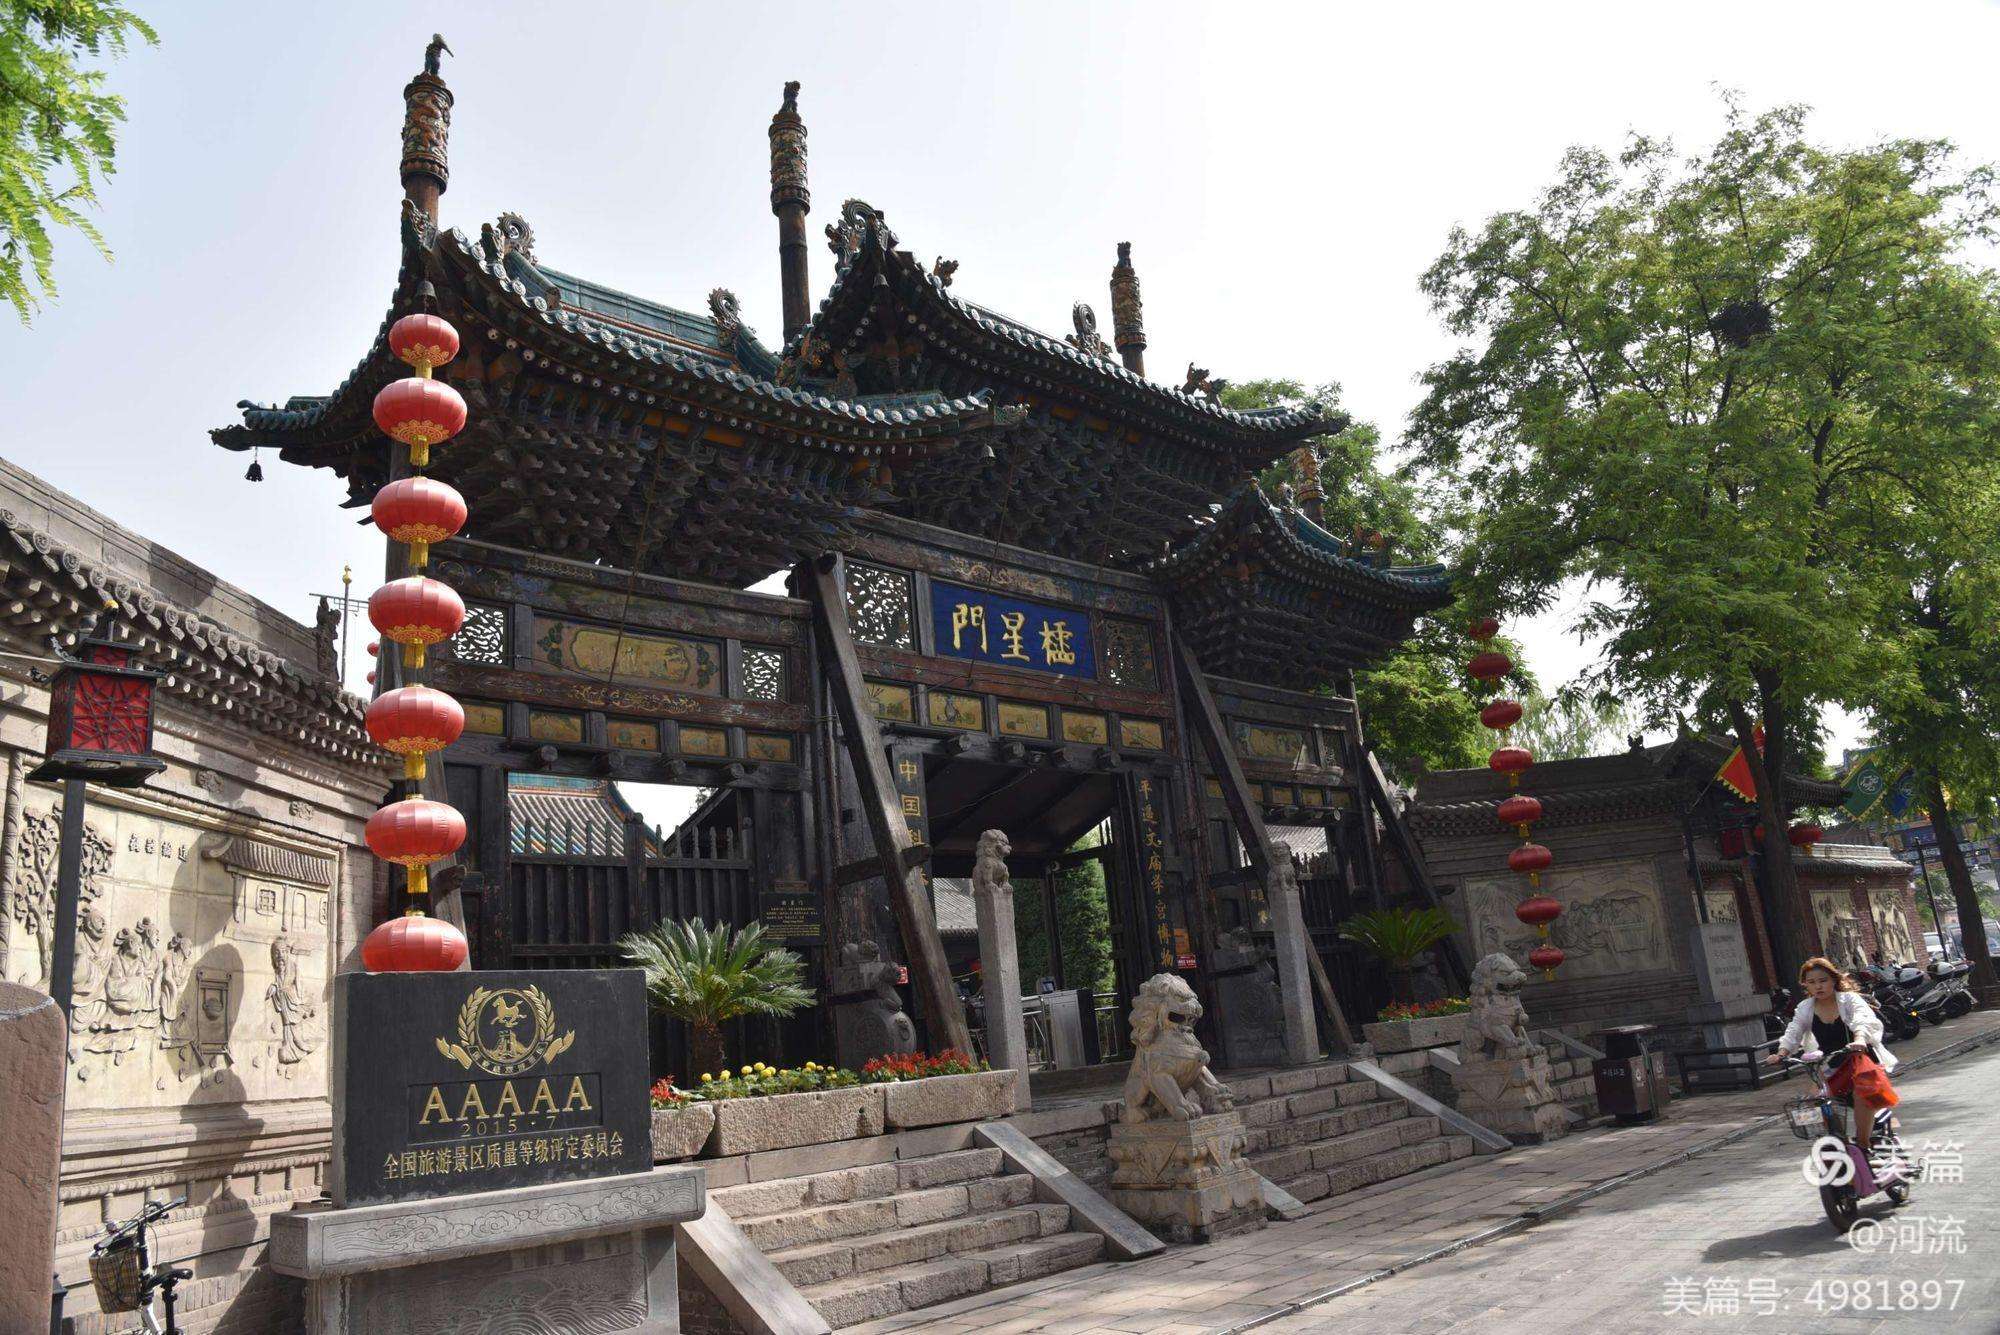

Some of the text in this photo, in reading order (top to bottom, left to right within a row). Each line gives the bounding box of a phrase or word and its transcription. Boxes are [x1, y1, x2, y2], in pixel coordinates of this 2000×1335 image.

[419, 1076, 593, 1124] AAAAA
[383, 1130, 624, 1180] 全国旅游景区质量等级评定委员会
